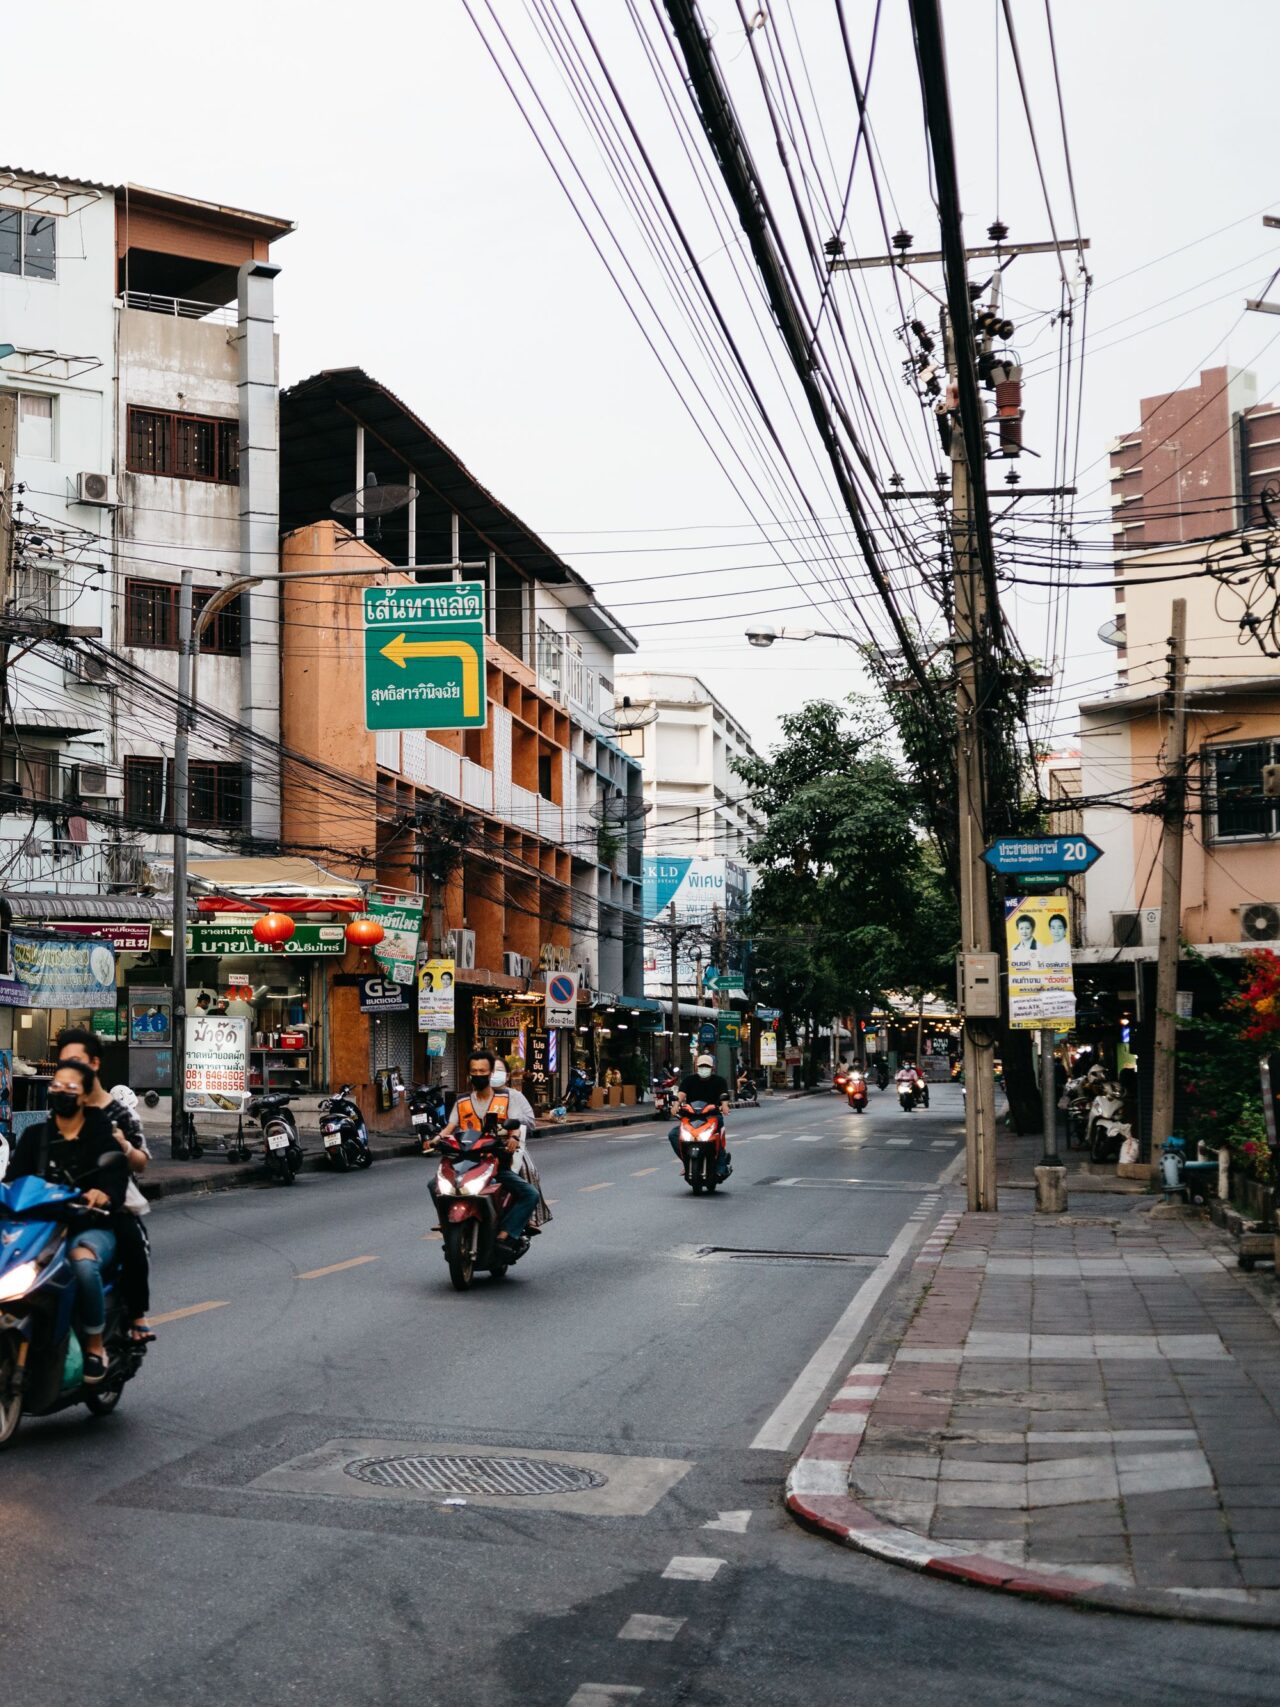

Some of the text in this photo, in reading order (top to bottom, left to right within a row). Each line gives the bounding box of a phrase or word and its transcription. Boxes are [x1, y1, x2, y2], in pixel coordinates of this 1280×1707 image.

[367, 586, 480, 620] เส้นทางลัด
[371, 681, 461, 706] สุทธิสารวินิจฉัย
[1063, 842, 1087, 861] 20
[688, 872, 724, 888] พิเศษ
[364, 978, 402, 997] GS
